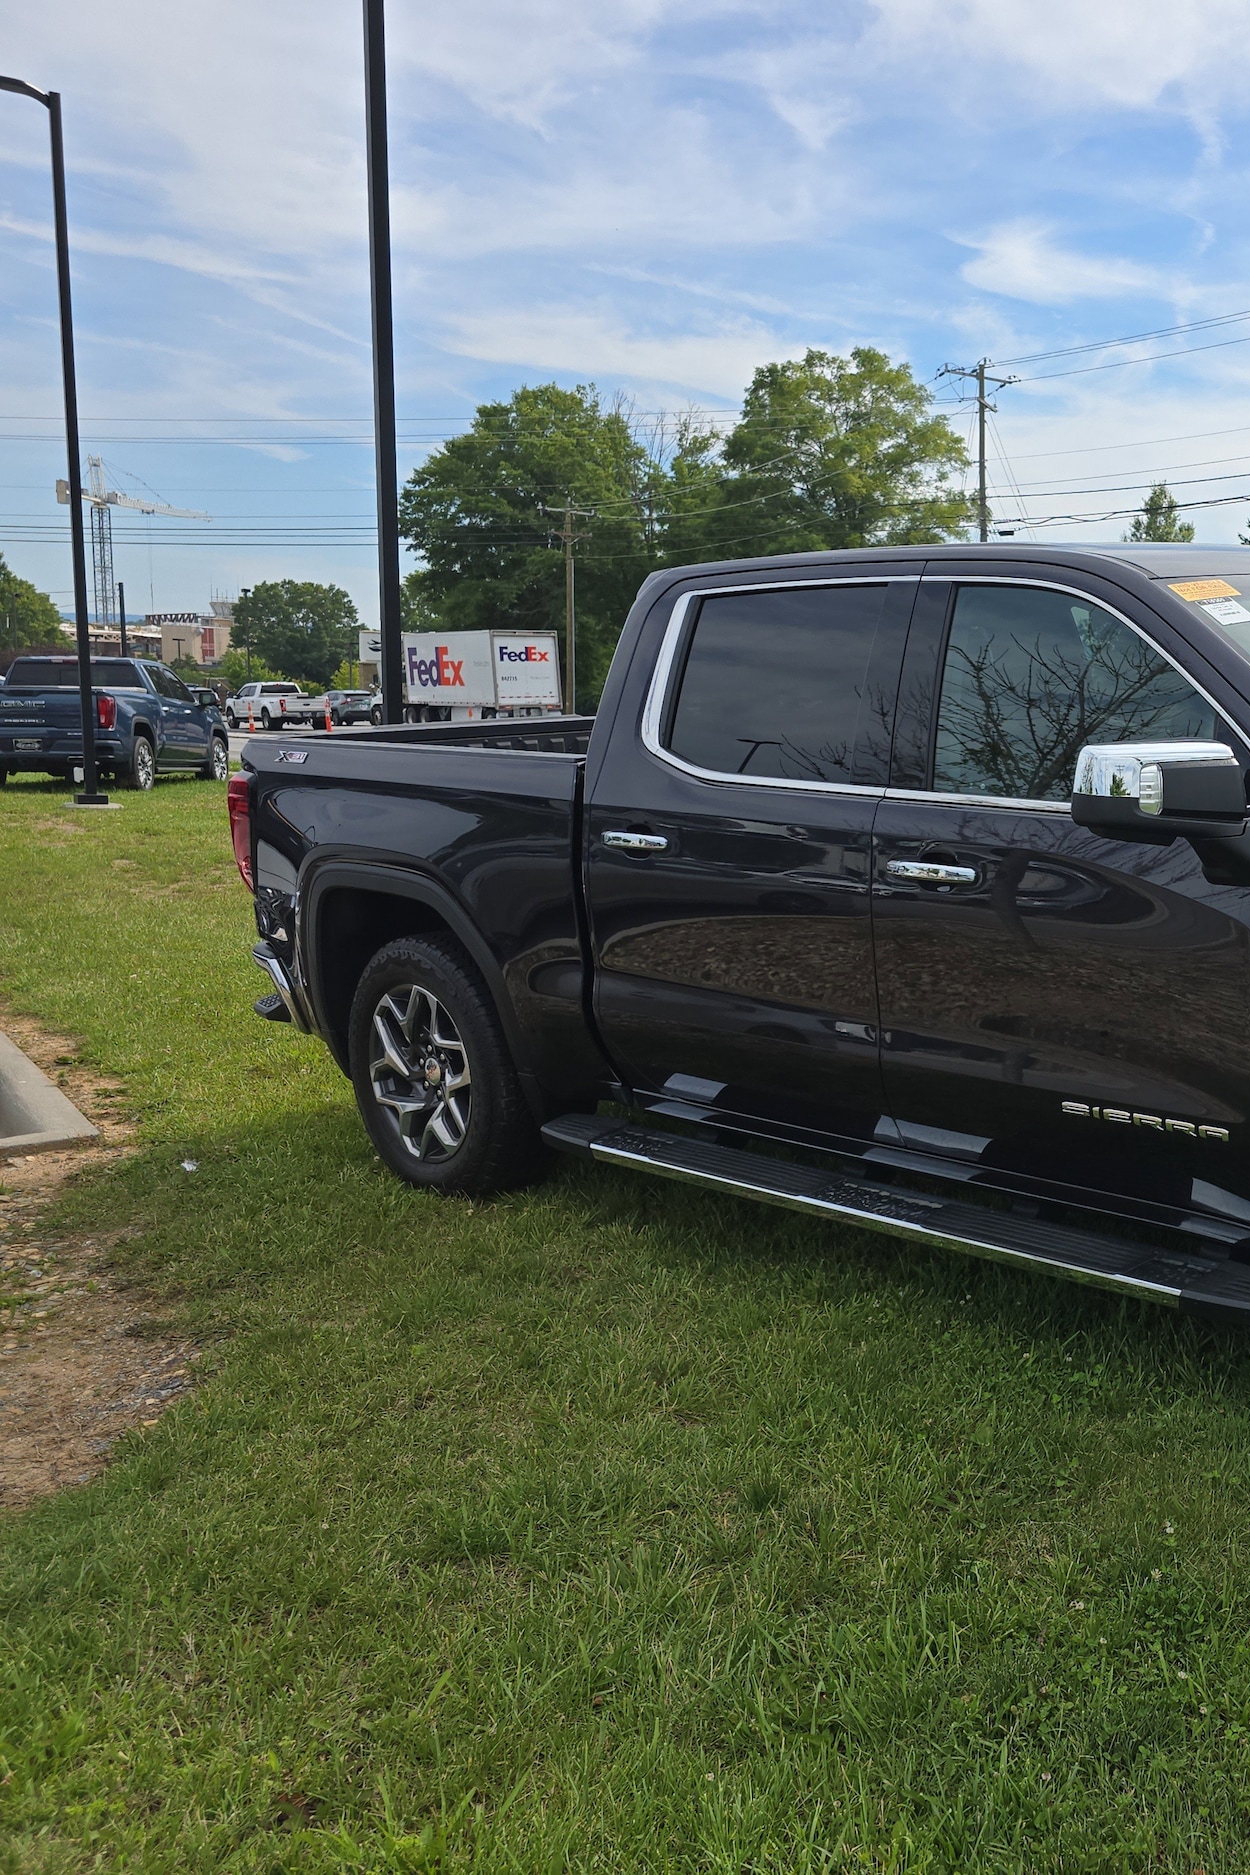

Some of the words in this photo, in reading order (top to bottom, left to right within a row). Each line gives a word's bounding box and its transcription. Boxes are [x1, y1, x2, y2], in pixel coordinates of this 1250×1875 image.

[407, 646, 465, 686] FedEx
[499, 646, 549, 662] FedEx
[0, 700, 45, 708] GMC
[1061, 1100, 1230, 1143] SIERRA
